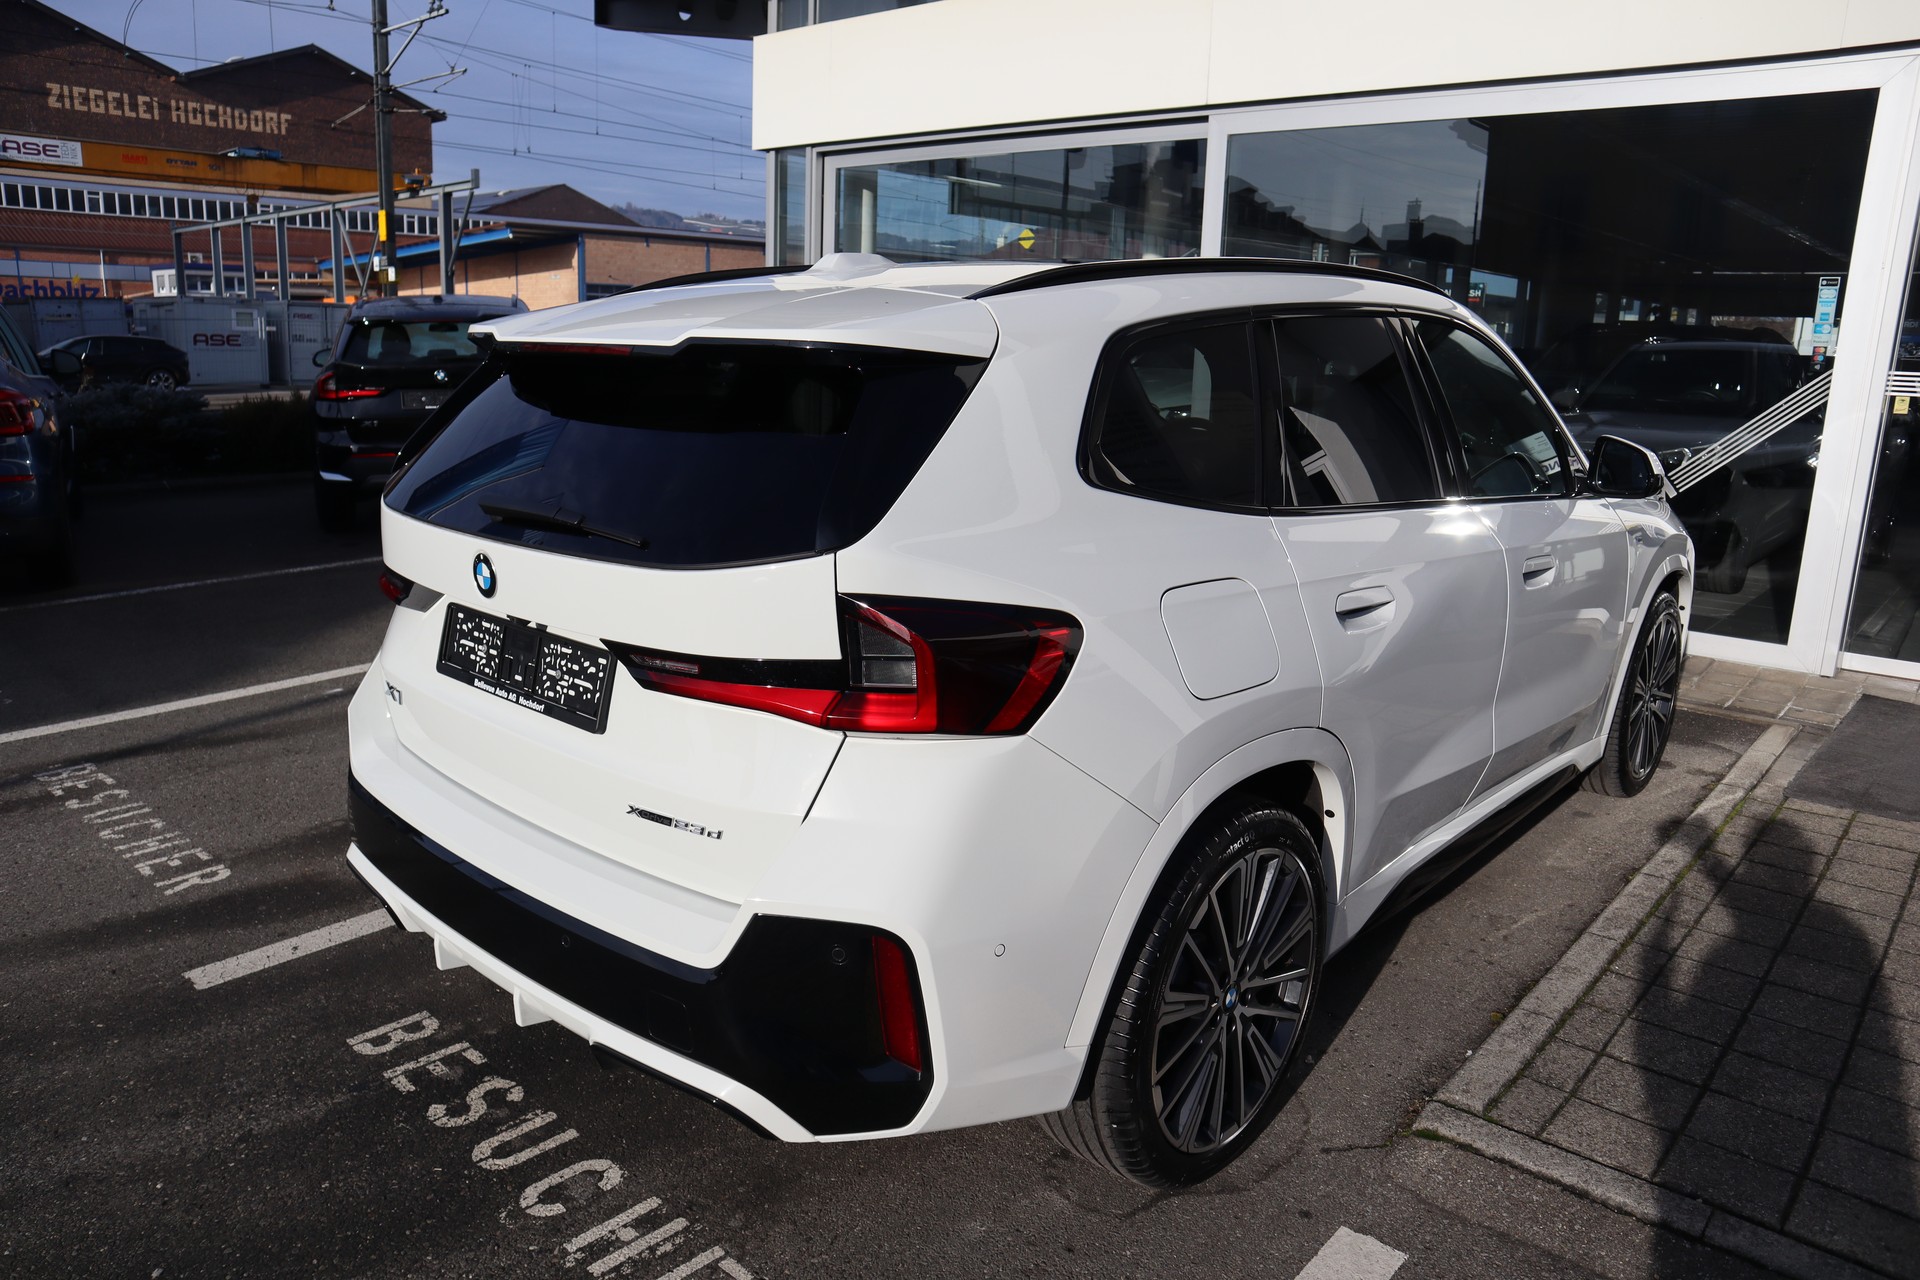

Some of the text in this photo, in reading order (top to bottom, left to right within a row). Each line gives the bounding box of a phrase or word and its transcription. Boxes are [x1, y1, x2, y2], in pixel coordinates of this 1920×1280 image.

[46, 82, 292, 135] ZIEGELEI HOCHDORF
[1, 139, 61, 159] ASE
[193, 333, 242, 347] ASE
[385, 680, 403, 705] X1
[473, 677, 545, 713] Bellevue Auto AG Hochdorf
[33, 762, 232, 896] BESUCHER
